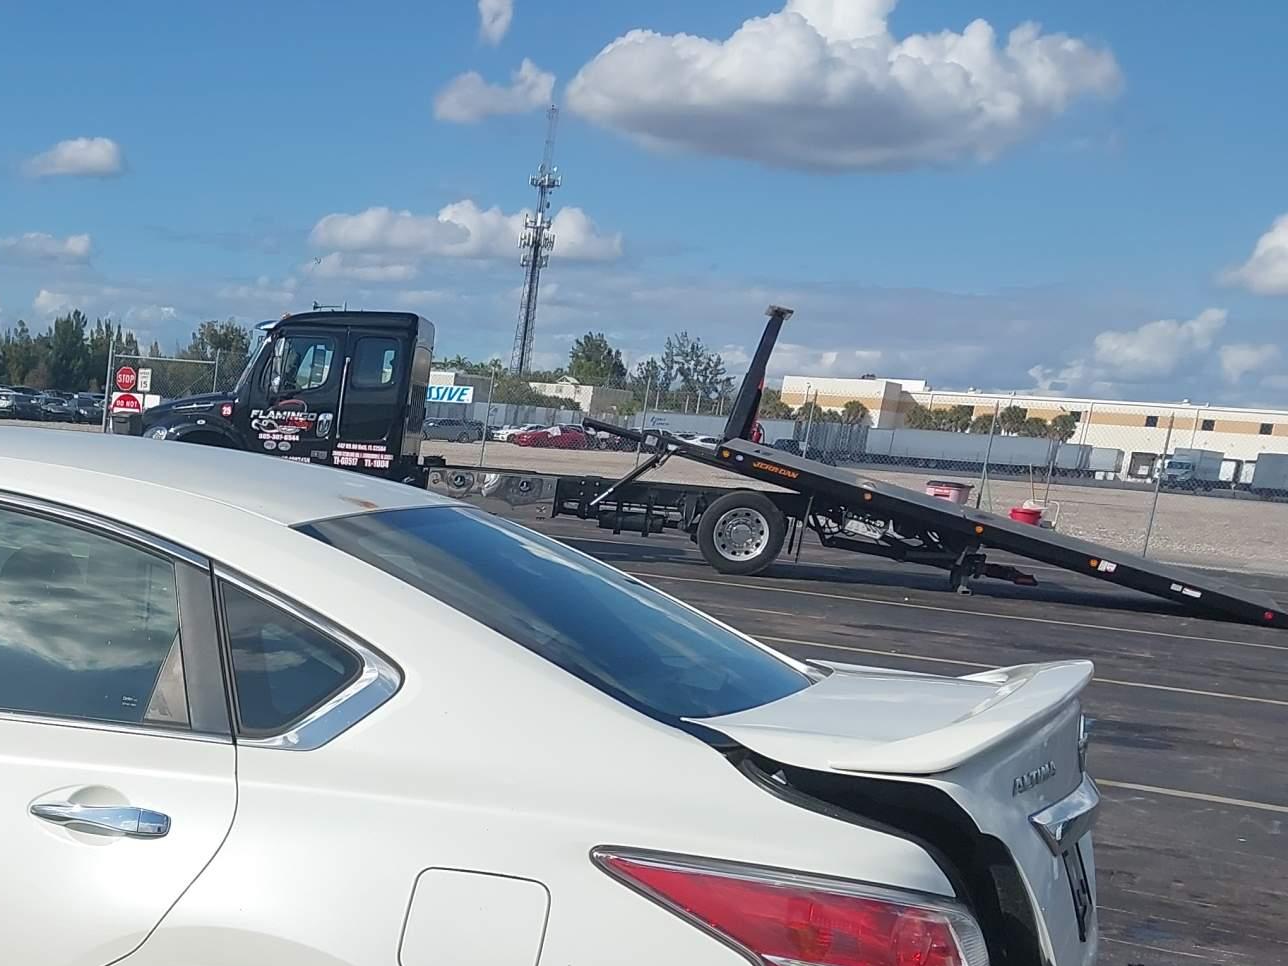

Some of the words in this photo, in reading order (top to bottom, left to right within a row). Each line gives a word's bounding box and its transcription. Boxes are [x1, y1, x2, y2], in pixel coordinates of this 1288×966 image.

[118, 374, 135, 383] STOP
[140, 380, 148, 388] 15
[250, 409, 317, 421] FLAMINGO
[1013, 760, 1056, 797] ALTIMA
